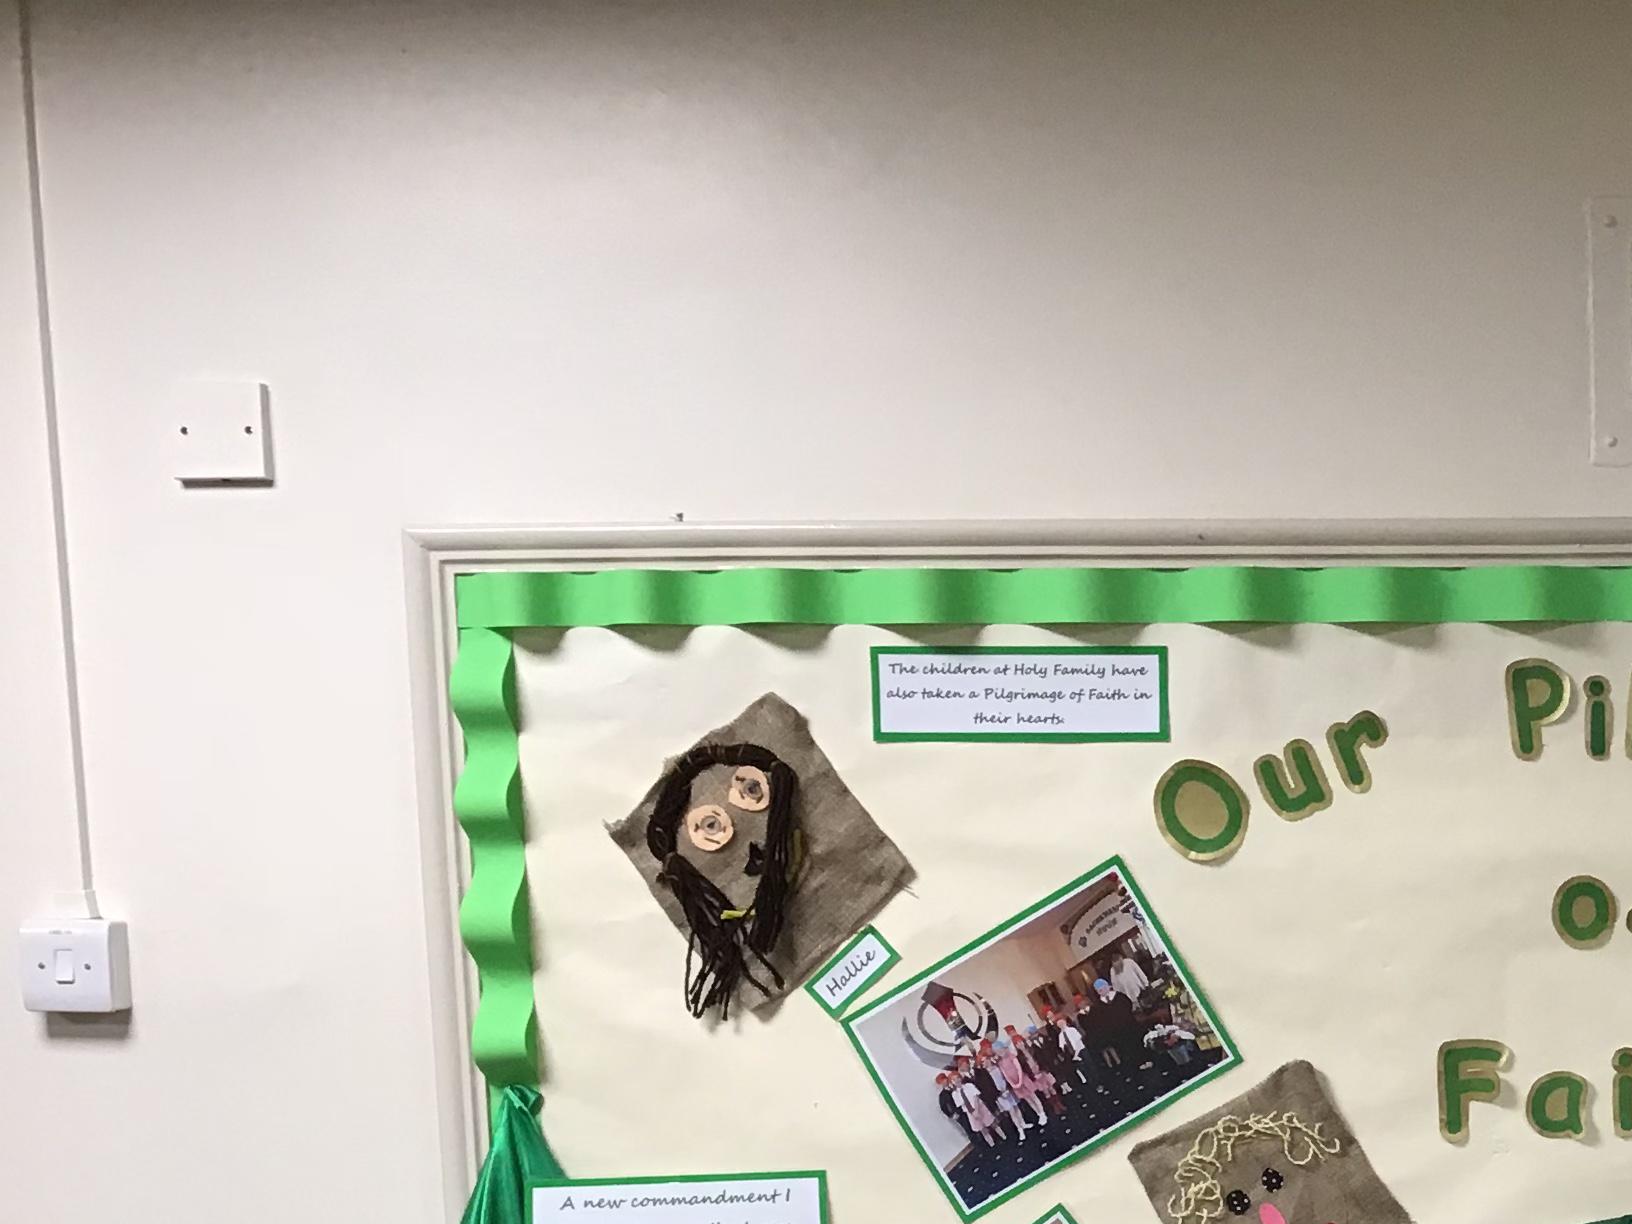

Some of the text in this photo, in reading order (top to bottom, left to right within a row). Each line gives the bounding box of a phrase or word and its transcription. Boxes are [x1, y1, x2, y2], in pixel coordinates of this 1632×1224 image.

[888, 663, 1148, 678] The children at Holy Family have
[887, 687, 1152, 703] also taken a Pilgrimage of Faith in
[973, 713, 1066, 726] their hearts.
[1152, 708, 1390, 865] Our
[826, 950, 876, 996] Hallie
[560, 1188, 791, 1210] A new commandment I
